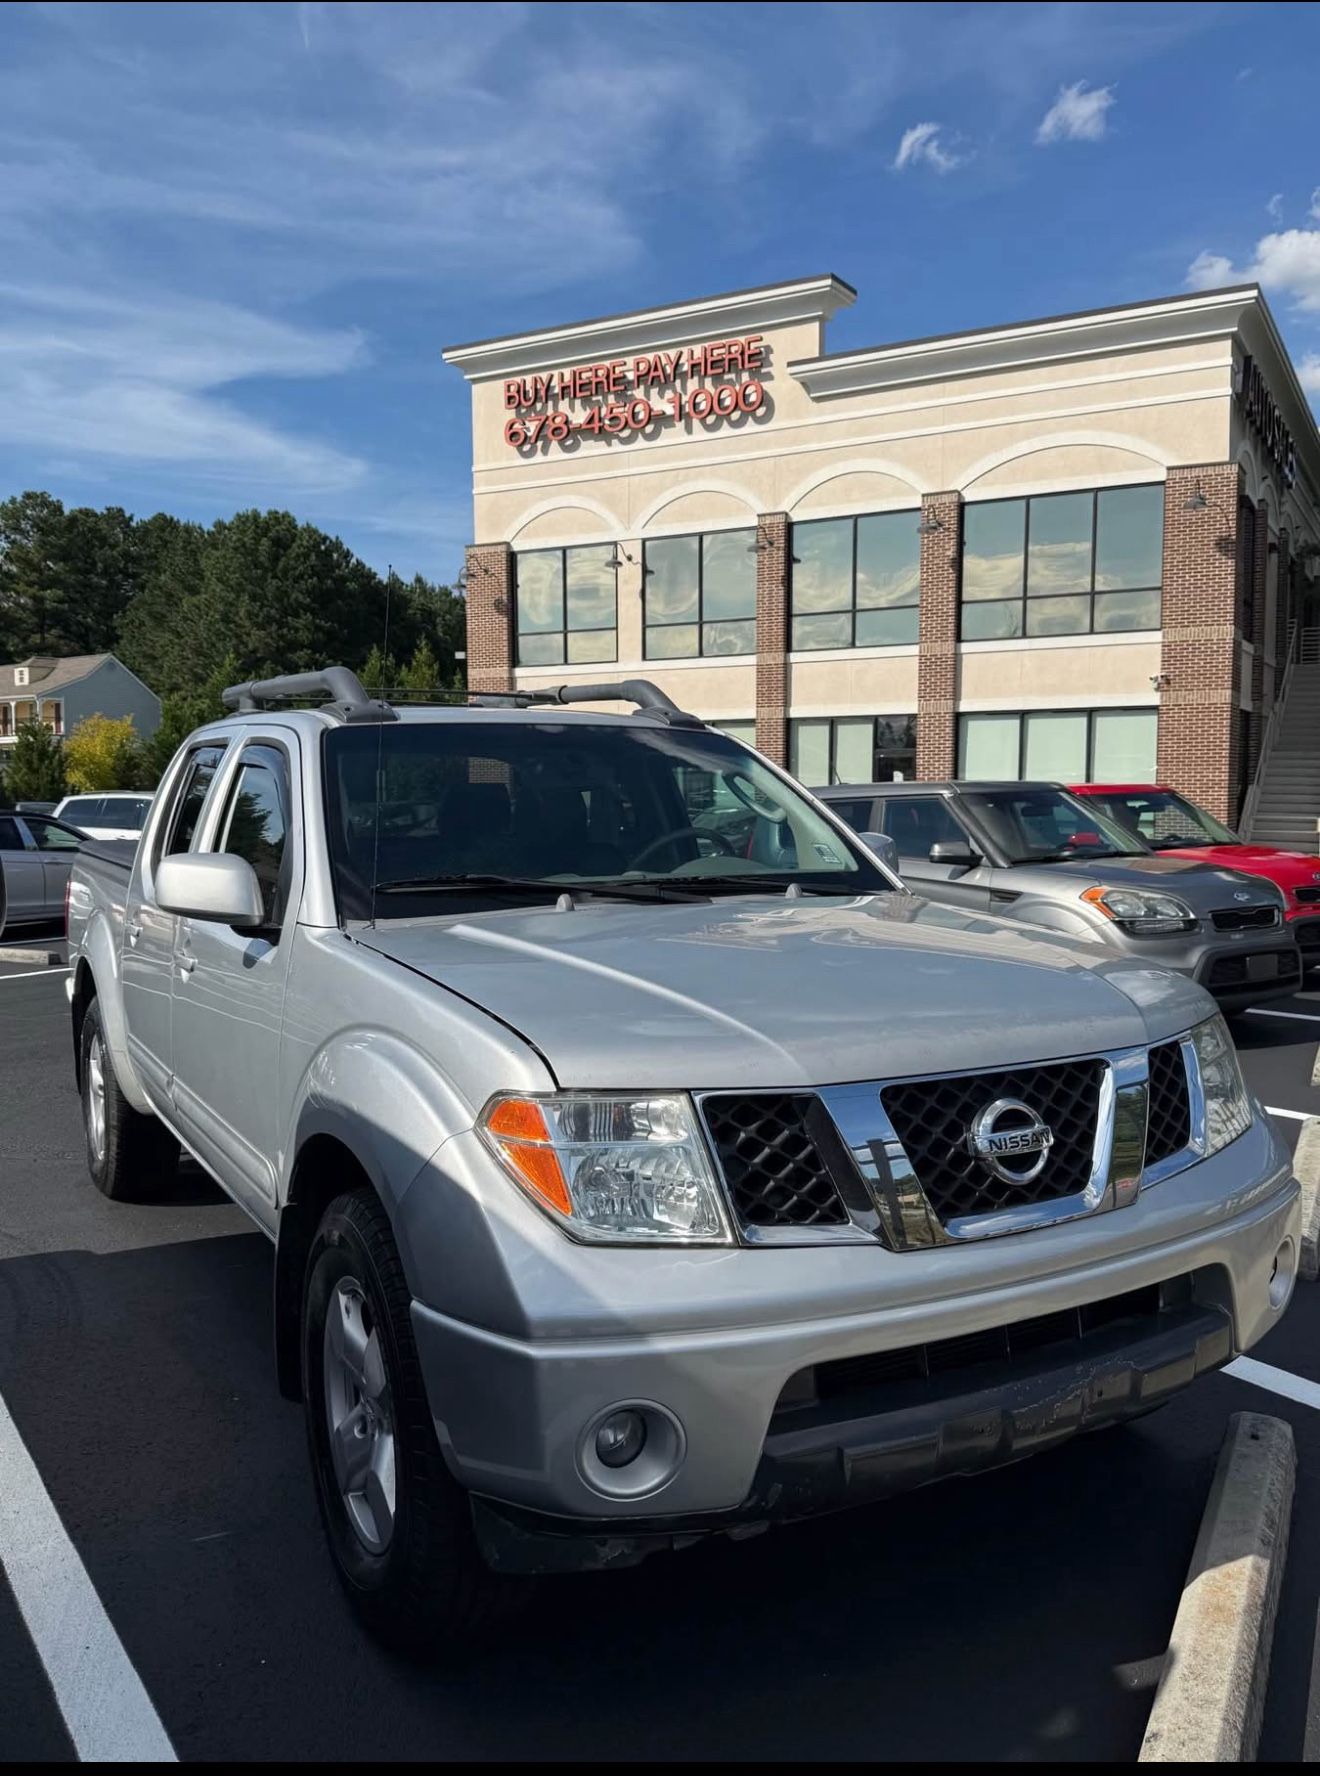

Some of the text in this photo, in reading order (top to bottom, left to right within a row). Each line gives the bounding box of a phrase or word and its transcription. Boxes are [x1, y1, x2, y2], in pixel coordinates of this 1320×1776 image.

[504, 335, 763, 410] BUY HERE PAY HERE
[504, 380, 764, 447] 678-450-1000
[988, 1130, 1051, 1152] NISSAN
